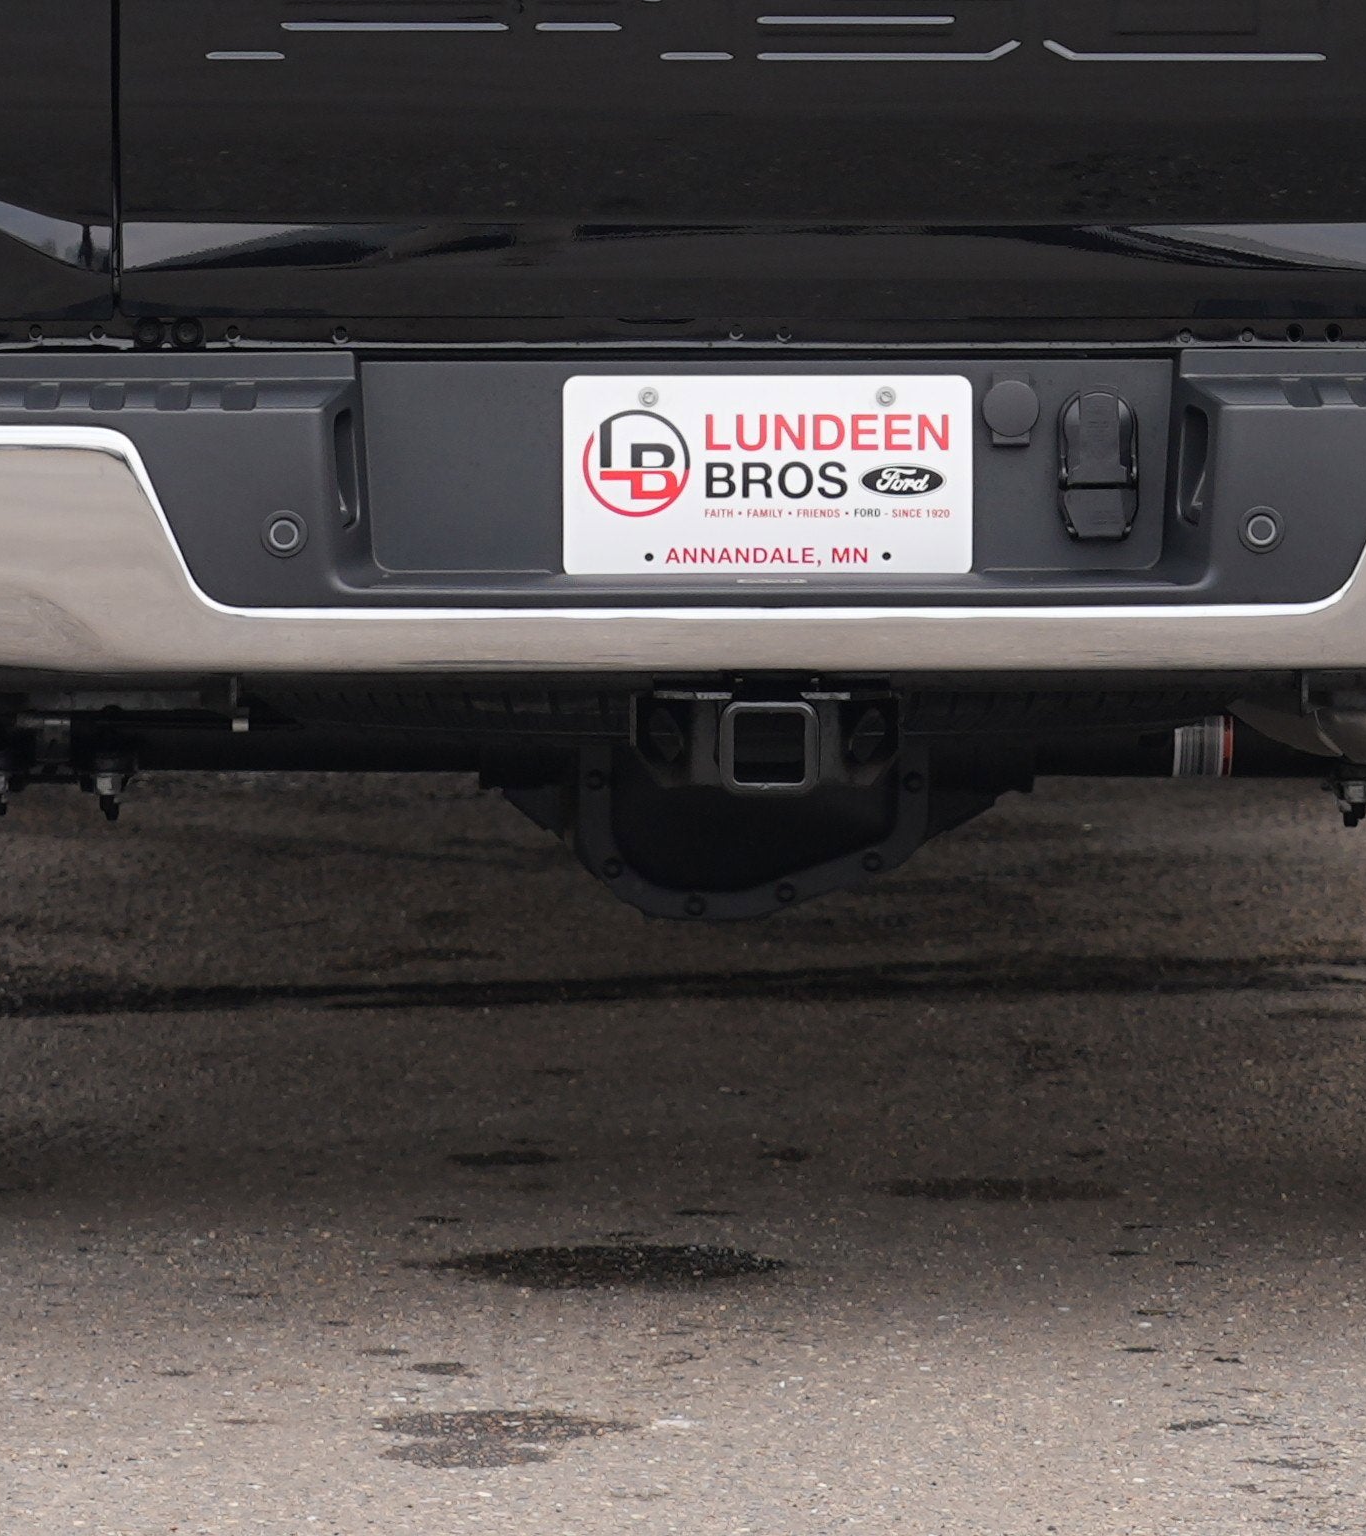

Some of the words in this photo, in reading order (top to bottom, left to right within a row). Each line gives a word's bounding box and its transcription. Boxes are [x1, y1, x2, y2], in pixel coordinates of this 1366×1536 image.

[705, 414, 949, 451] LUNDEEN
[705, 462, 848, 499] BROS
[875, 468, 931, 492] Ford
[704, 509, 734, 518] FAITH
[746, 509, 783, 518] FAMILY
[796, 509, 841, 518] FRIENDS
[854, 509, 881, 518] FORD
[892, 509, 922, 518] SINCE
[665, 547, 822, 567] ANNANDALE,
[831, 547, 868, 564] MN
